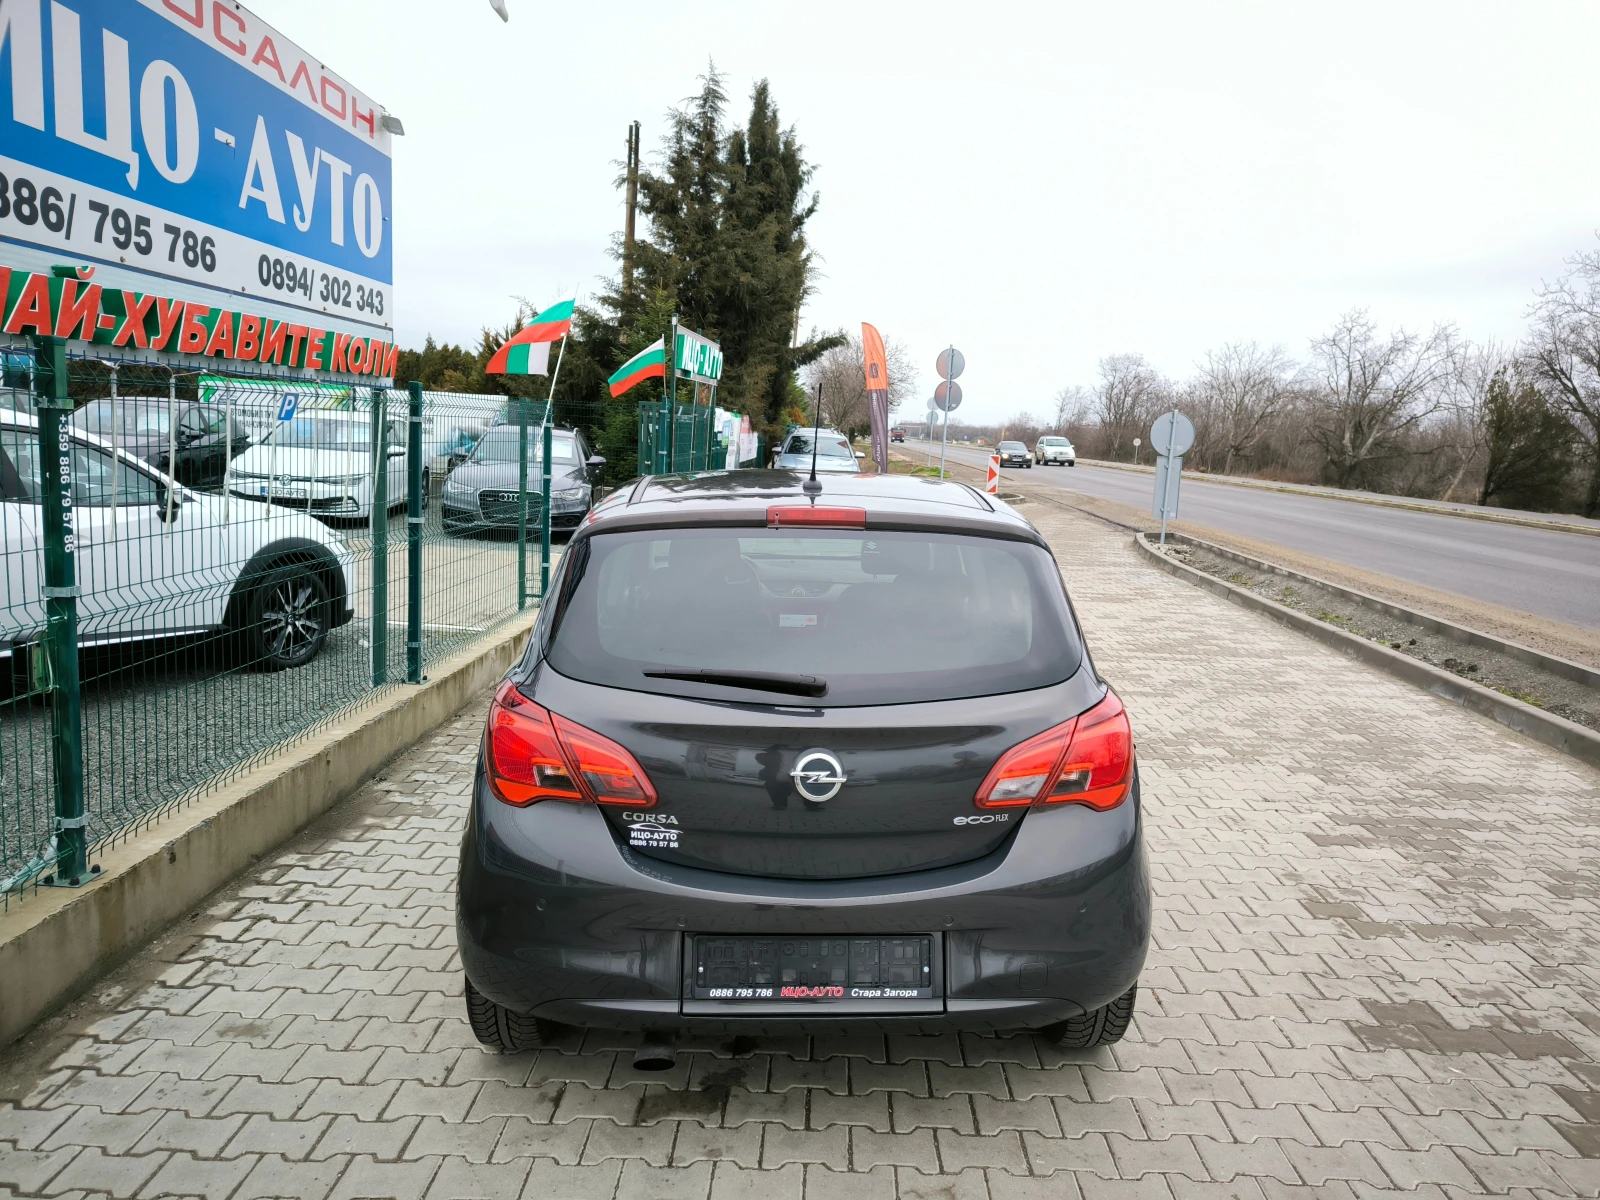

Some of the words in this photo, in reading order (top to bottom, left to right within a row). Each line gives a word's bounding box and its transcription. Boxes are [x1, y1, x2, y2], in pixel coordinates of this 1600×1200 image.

[89, 199, 153, 256] 795
[163, 222, 216, 273] 786
[258, 254, 315, 301] 0894/
[320, 273, 352, 308] 302
[356, 284, 384, 316] 343
[0, 264, 326, 370] АЙ-ХУБАВИТЕ
[330, 331, 399, 378] КОЛИ
[58, 413, 69, 452] +359
[59, 456, 71, 484] 886
[61, 488, 72, 507] 79
[62, 512, 73, 529] 57
[64, 534, 75, 553] 86
[622, 811, 679, 825] CORSA
[629, 839, 647, 847] 0886
[630, 830, 677, 840] ИЦО-АУТО
[709, 988, 733, 997] 0886
[735, 988, 753, 997] 795
[755, 988, 773, 997] 786
[780, 986, 845, 998] ИЦО-АУТО
[851, 988, 881, 998] Стара
[883, 988, 918, 998] Загора
